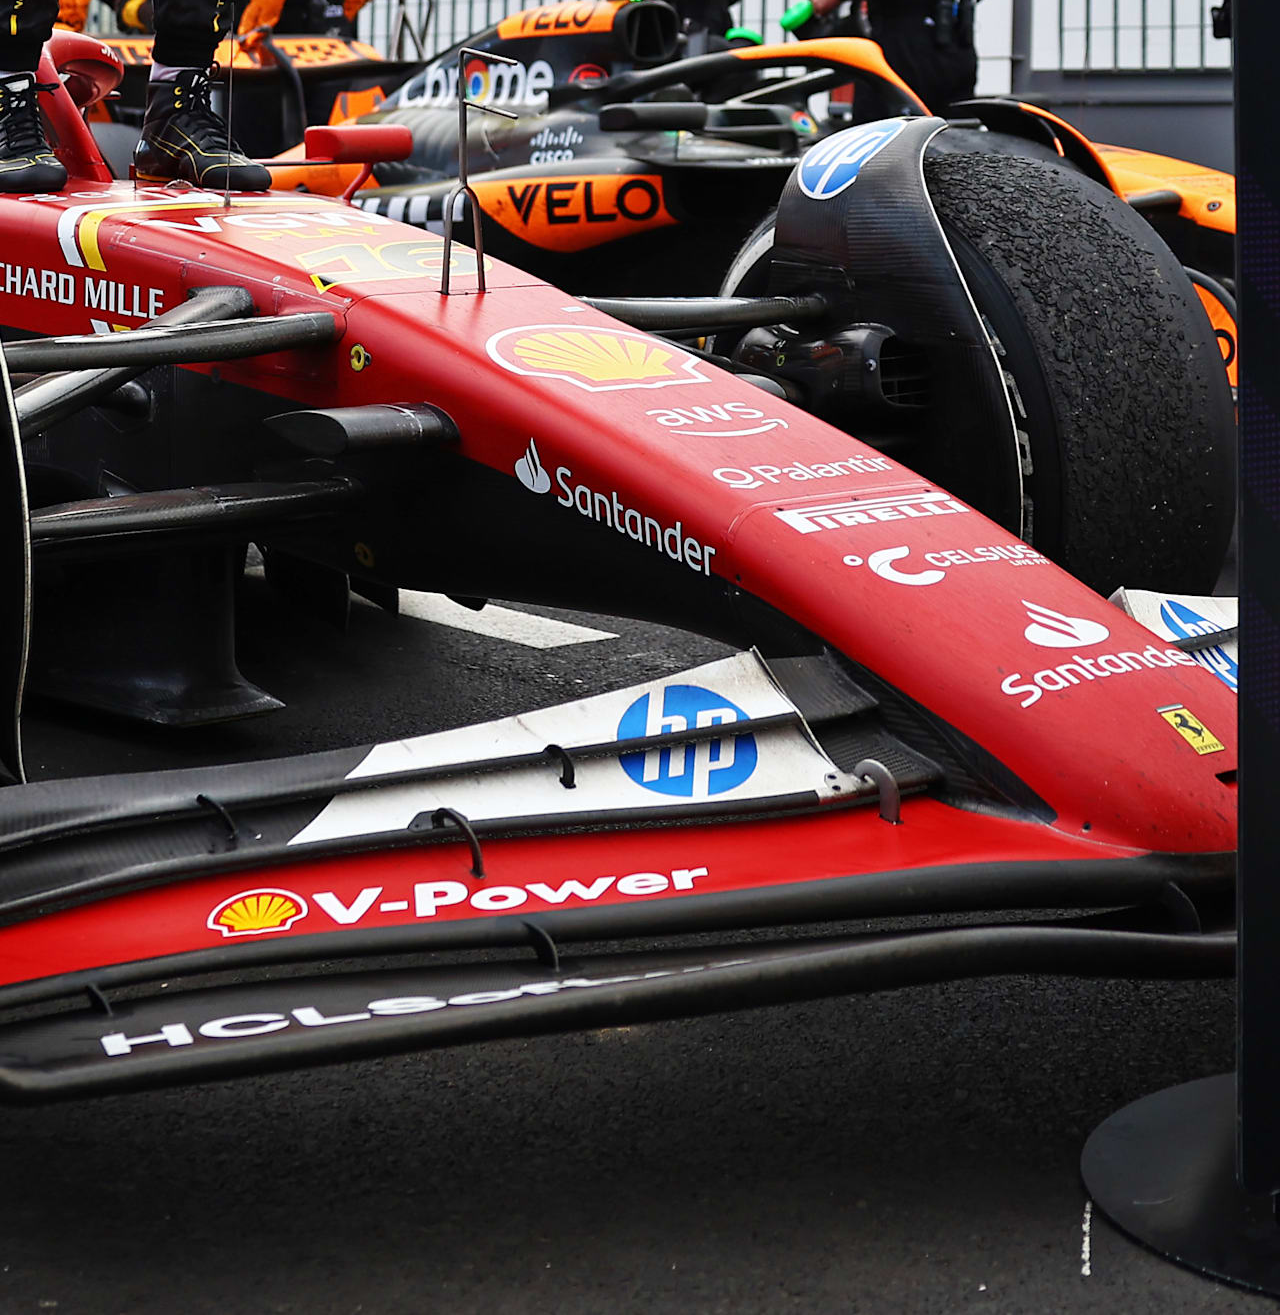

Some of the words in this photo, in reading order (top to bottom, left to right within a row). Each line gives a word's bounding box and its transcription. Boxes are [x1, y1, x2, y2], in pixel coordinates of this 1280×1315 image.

[521, 1, 596, 31] VELO
[529, 149, 575, 166] cisco
[507, 178, 661, 226] VELO
[295, 239, 494, 294] 16
[84, 277, 165, 320] MILLE
[645, 400, 764, 428] aws
[752, 454, 894, 484] Palantir
[555, 465, 717, 579] Santander
[773, 491, 970, 534] PIRELLI
[633, 685, 746, 797] hp
[313, 867, 709, 926] V-Power
